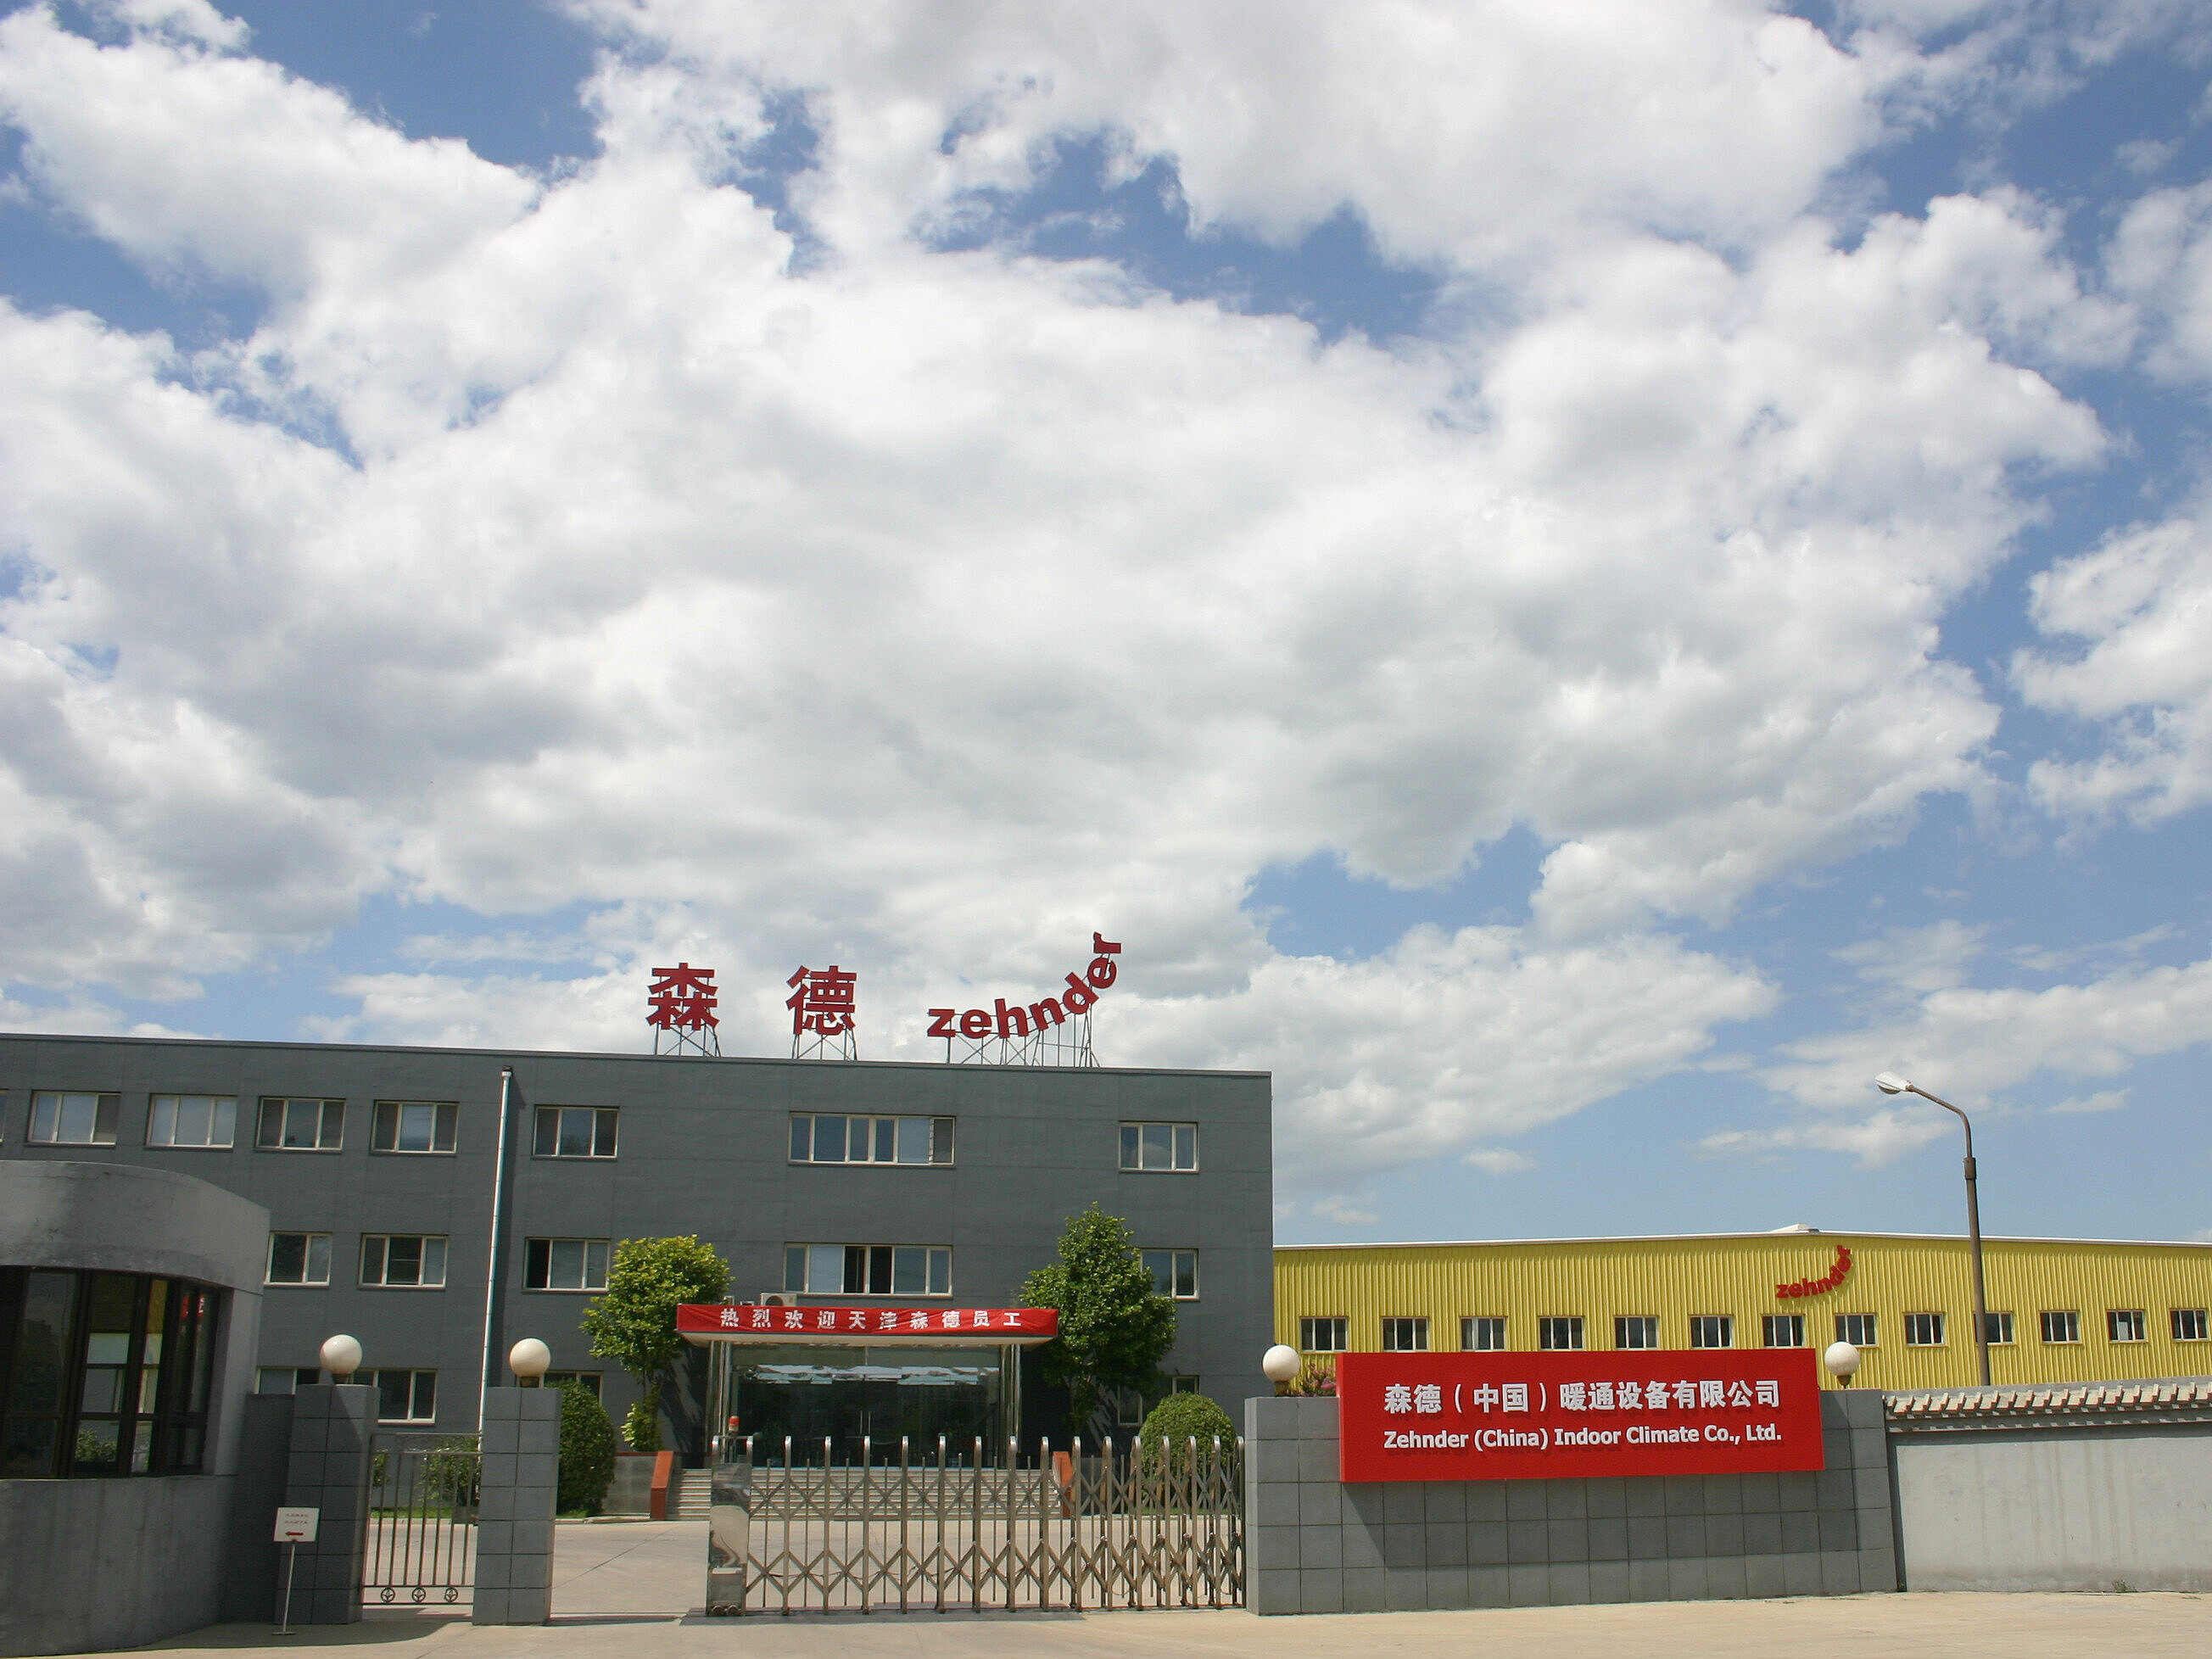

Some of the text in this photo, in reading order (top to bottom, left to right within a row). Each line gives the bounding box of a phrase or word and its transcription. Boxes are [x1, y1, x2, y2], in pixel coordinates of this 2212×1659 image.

[646, 963, 857, 1036] 森德
[928, 932, 1122, 1039] zehnder
[1776, 1245, 1851, 1299] zehnder
[720, 1308, 1023, 1332] 热烈欢迎天津森德员工
[1383, 1379, 1780, 1414] 森德（中国）暖通设备有限公司
[1382, 1422, 1783, 1451] Zehnder (China) Indoor Climate Co., Ltd.
